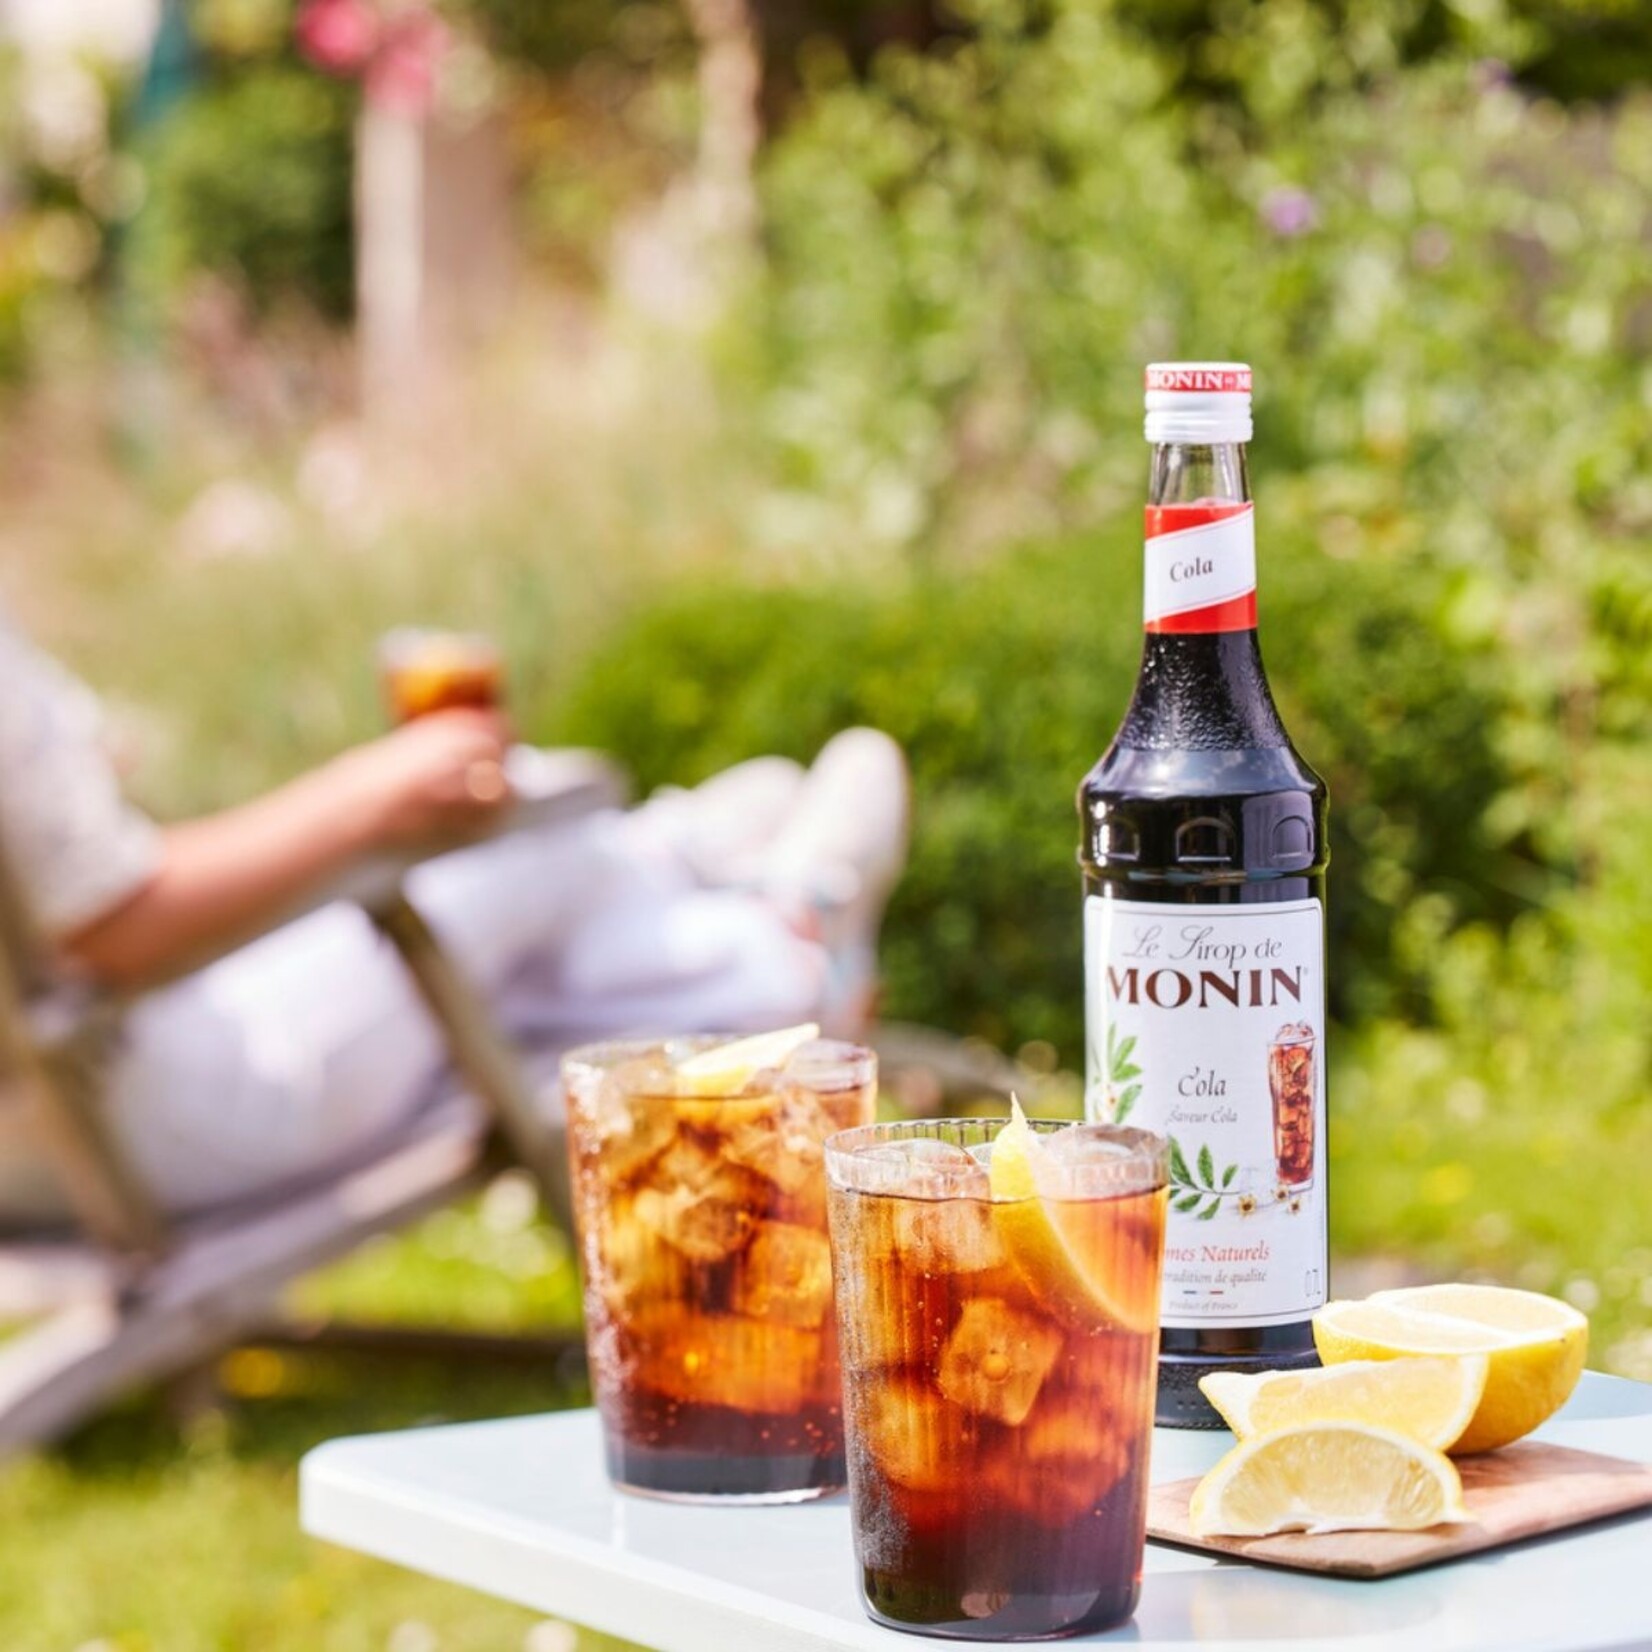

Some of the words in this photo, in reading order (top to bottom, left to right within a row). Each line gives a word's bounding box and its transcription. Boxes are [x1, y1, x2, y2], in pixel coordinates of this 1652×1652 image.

[1169, 556, 1214, 583] Cola
[1122, 925, 1163, 959] Le
[1168, 925, 1246, 969] Sirop
[1254, 938, 1283, 959] de
[1107, 965, 1302, 1009] MONIN
[1177, 1066, 1227, 1098] Cola
[1210, 1105, 1239, 1124] Cola
[1201, 1239, 1270, 1262] Naturels
